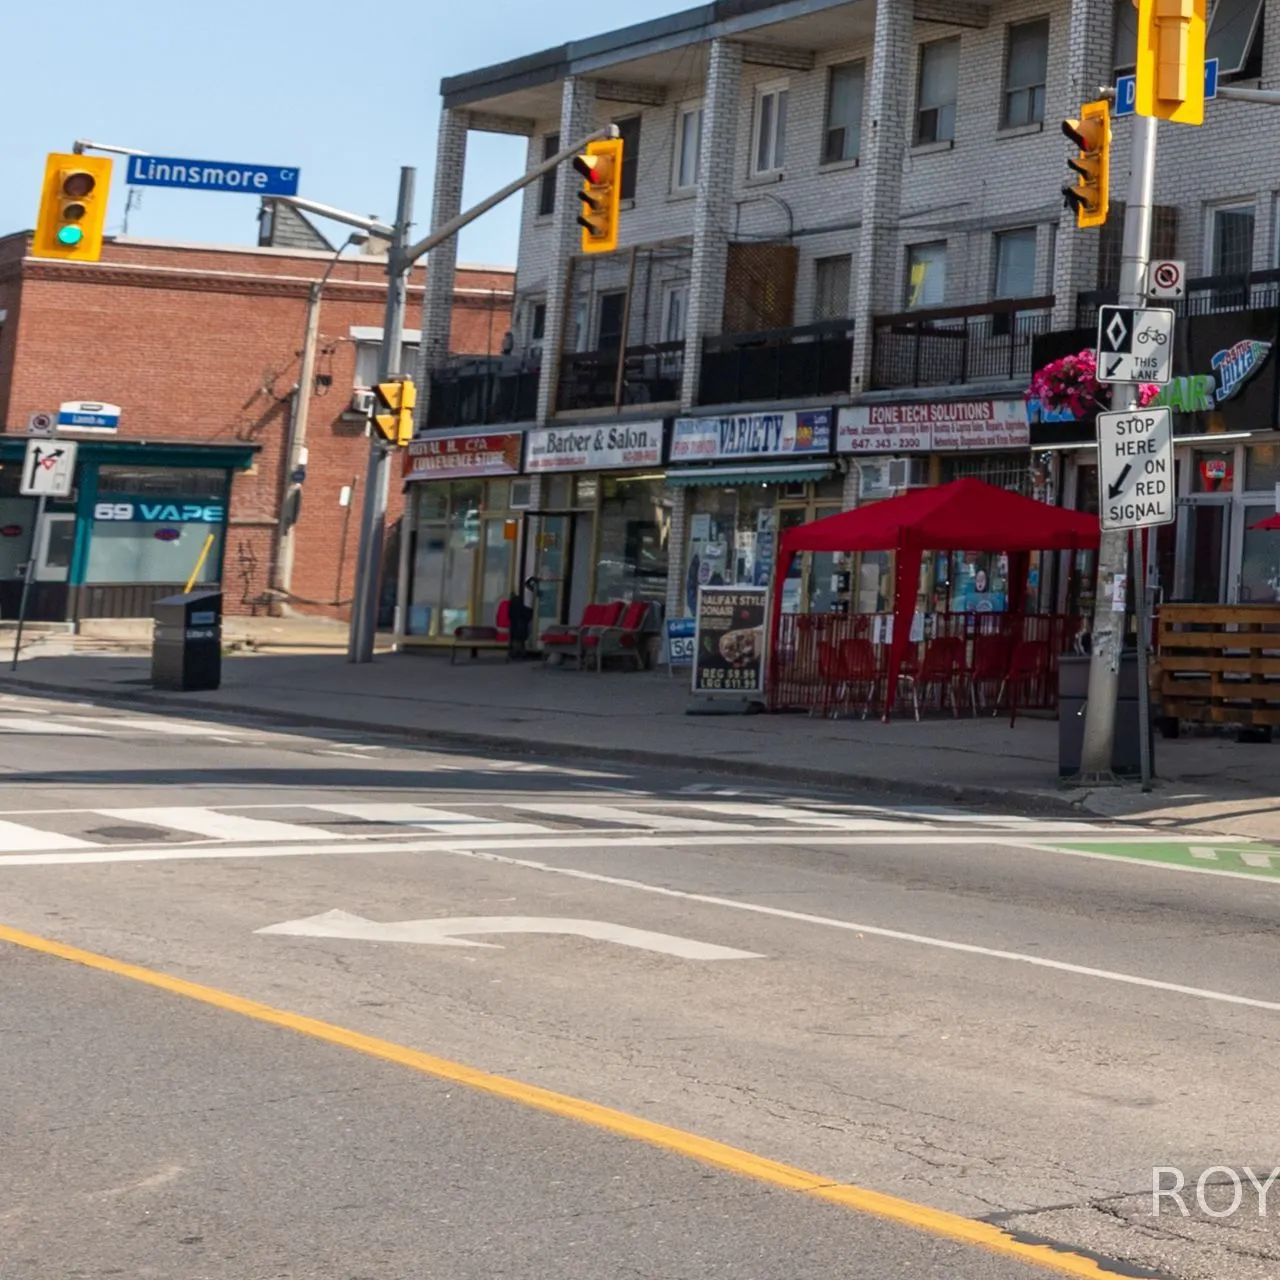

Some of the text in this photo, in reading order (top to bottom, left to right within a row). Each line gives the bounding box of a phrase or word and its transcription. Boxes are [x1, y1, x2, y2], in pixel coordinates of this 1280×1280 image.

[134, 158, 295, 188] Linnsmore Cr
[1135, 357, 1158, 368] THIS
[1131, 369, 1158, 380] LANE
[1157, 375, 1208, 414] NAIR
[872, 402, 989, 423] FONE TECH SOLUTIONS
[719, 414, 784, 455] VARIETY
[1116, 418, 1155, 435] STOP
[546, 431, 591, 454] Barber
[594, 428, 604, 451] &
[607, 427, 648, 450] Salon
[1115, 439, 1156, 457] HERE
[1145, 459, 1165, 474] ON
[1136, 480, 1165, 496] RED
[94, 503, 225, 522] 69 VAPE
[1110, 501, 1165, 520] SIGNAL
[702, 595, 766, 606] HALIFAX STYLE
[703, 667, 724, 678] REG
